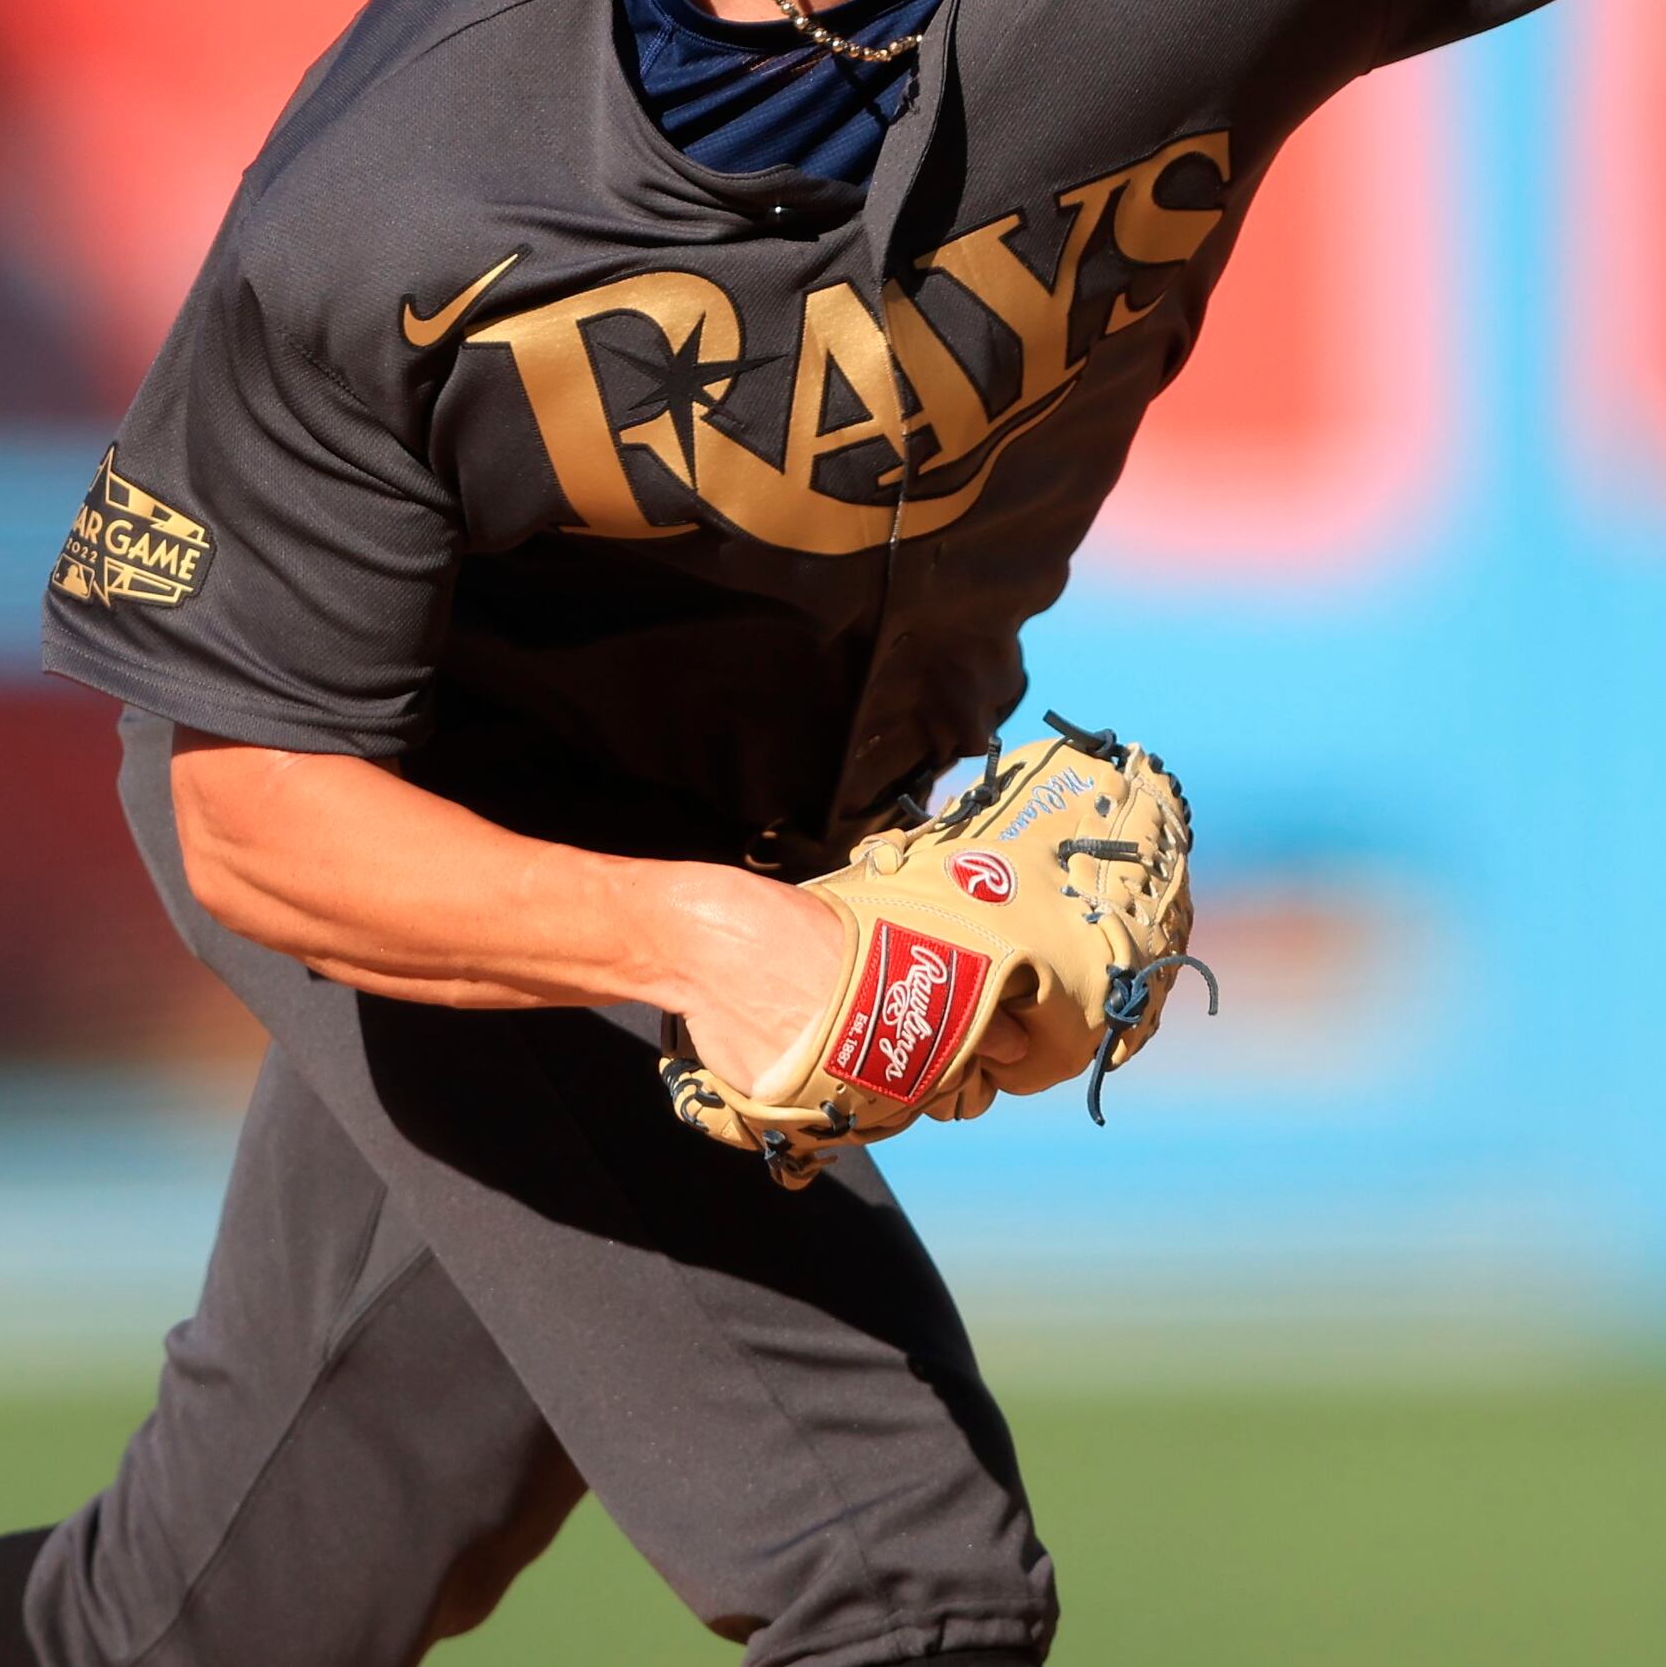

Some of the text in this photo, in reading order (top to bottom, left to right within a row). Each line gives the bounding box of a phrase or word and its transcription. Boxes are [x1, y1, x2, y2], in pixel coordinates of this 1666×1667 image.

[462, 129, 1233, 557] RAYS
[71, 505, 201, 581] AR GAME
[836, 1011, 869, 1069] Est. 1887
[879, 944, 948, 1082] Rawlings
